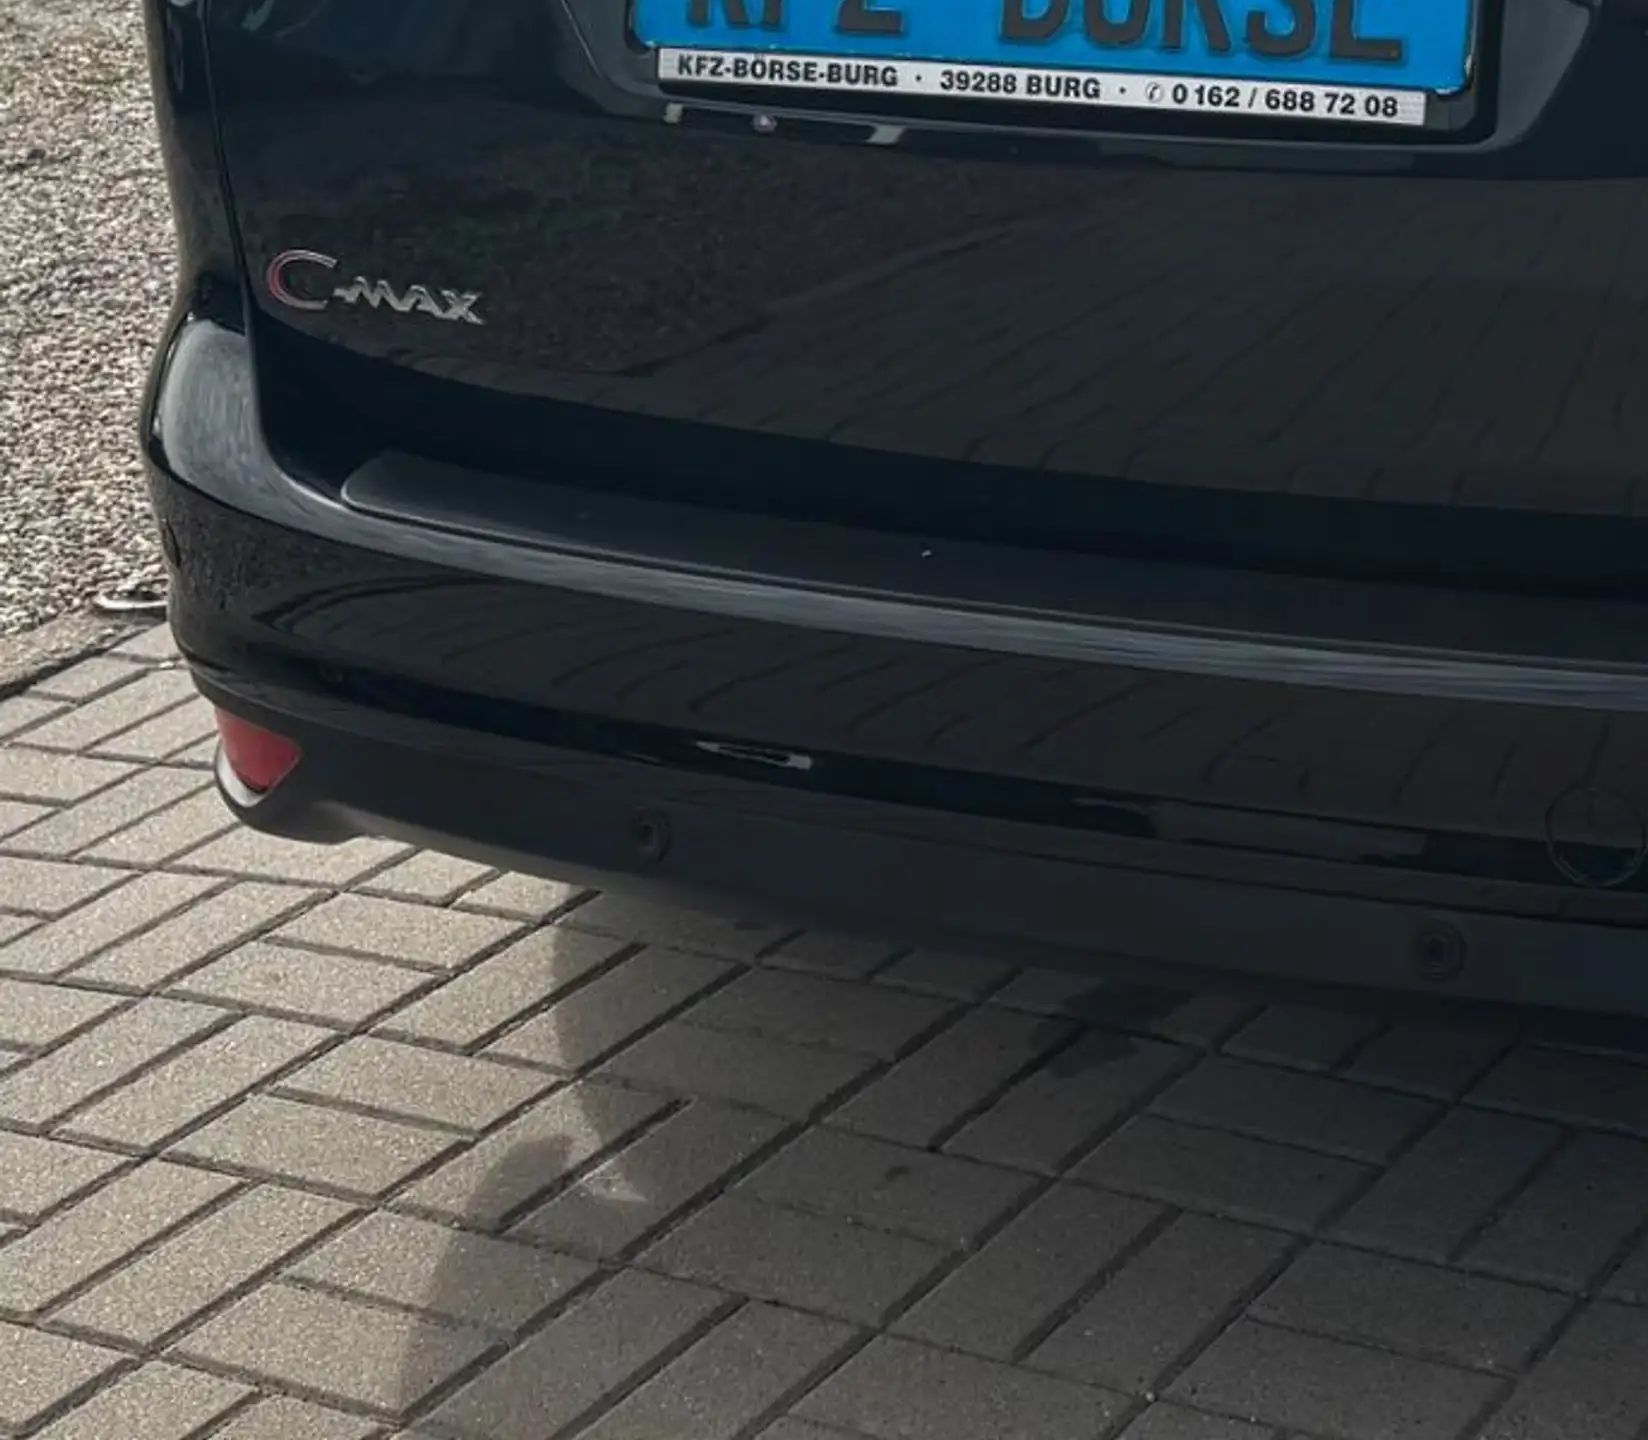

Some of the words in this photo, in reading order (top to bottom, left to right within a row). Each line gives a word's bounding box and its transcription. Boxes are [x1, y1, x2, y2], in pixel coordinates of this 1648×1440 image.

[678, 53, 898, 87] KFZ-BÖRSE-BURG
[940, 70, 1017, 93] 39288
[1026, 74, 1101, 99] BURG
[1264, 88, 1315, 112] 688
[1324, 92, 1356, 115] 72
[1364, 96, 1399, 118] 08
